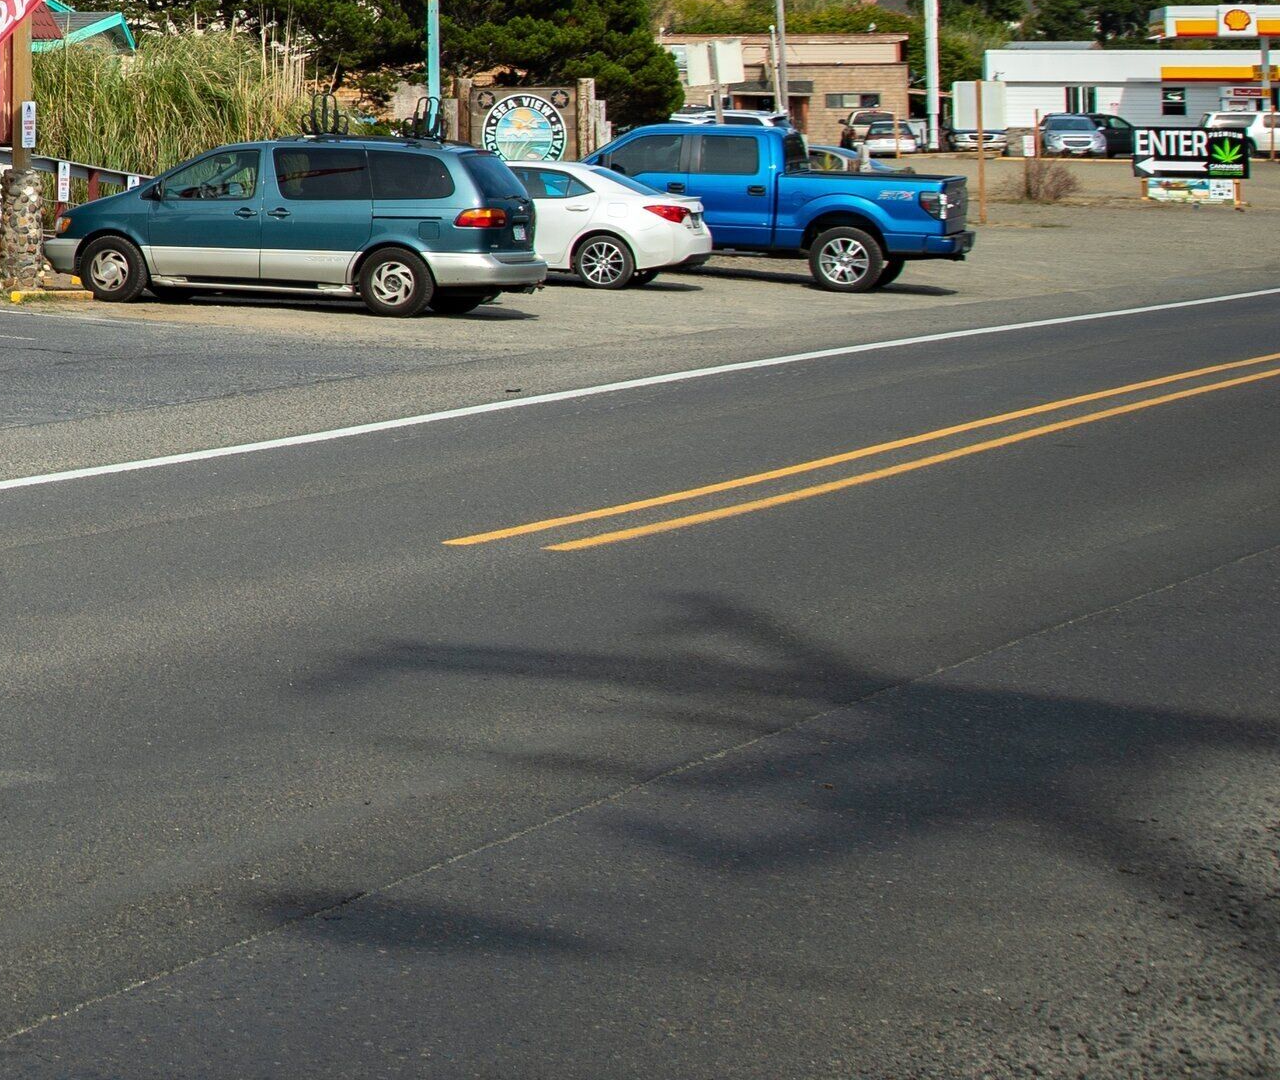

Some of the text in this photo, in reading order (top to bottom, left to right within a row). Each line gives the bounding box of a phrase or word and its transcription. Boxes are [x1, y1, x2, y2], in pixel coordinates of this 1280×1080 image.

[492, 97, 554, 120] SEA VIEW
[1134, 129, 1209, 157] ENTER
